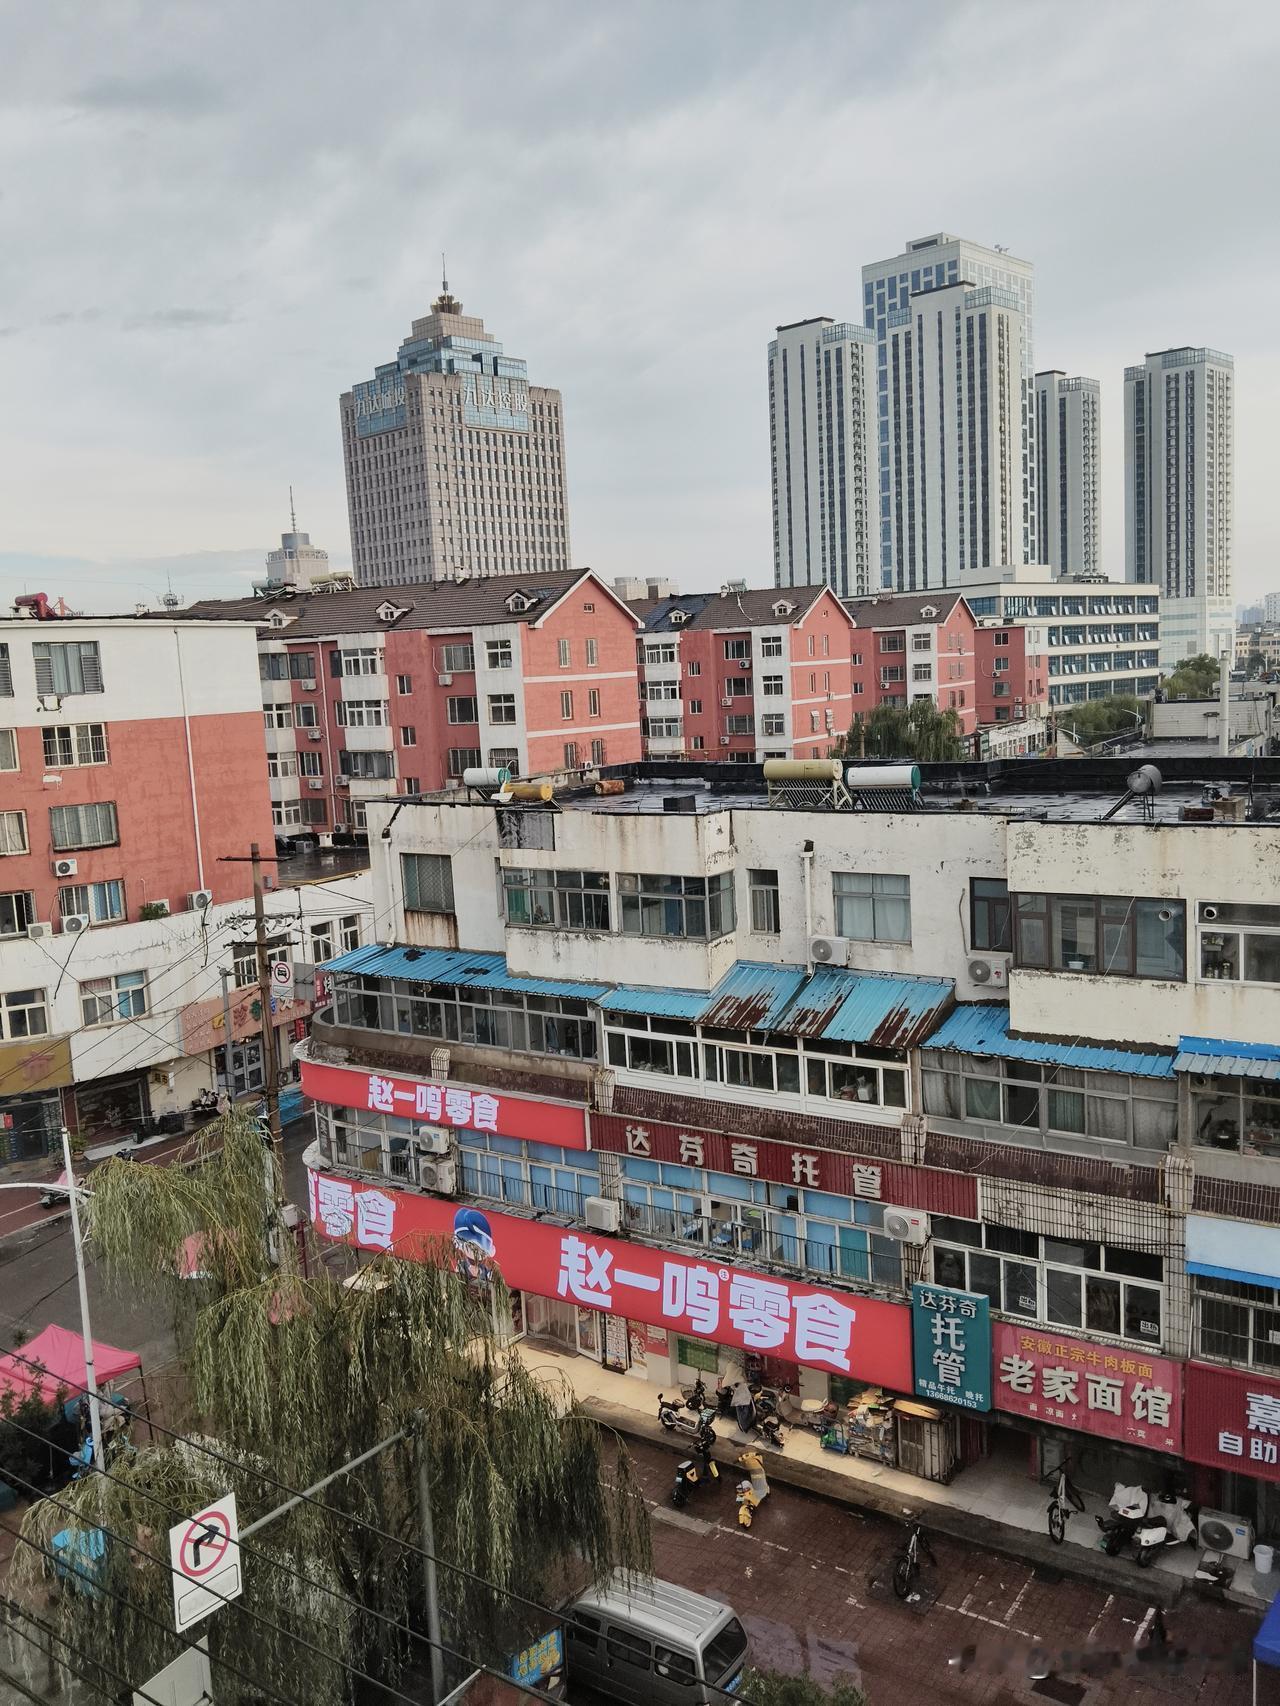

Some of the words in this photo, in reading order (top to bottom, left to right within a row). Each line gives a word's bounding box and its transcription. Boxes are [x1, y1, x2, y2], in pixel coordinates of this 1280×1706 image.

[463, 384, 528, 412] 九达控股
[368, 1075, 500, 1134] 赵一鸣零食
[625, 1124, 883, 1200] 达芬奇托管
[557, 1235, 857, 1372] 赵一鸣零食
[919, 1288, 977, 1319] 达芬奇
[931, 1313, 966, 1387] 托管
[1019, 1335, 1153, 1379] 安徽正宗牛肉板面
[999, 1353, 1172, 1428] 老家面馆
[1218, 1431, 1277, 1464] 自助
